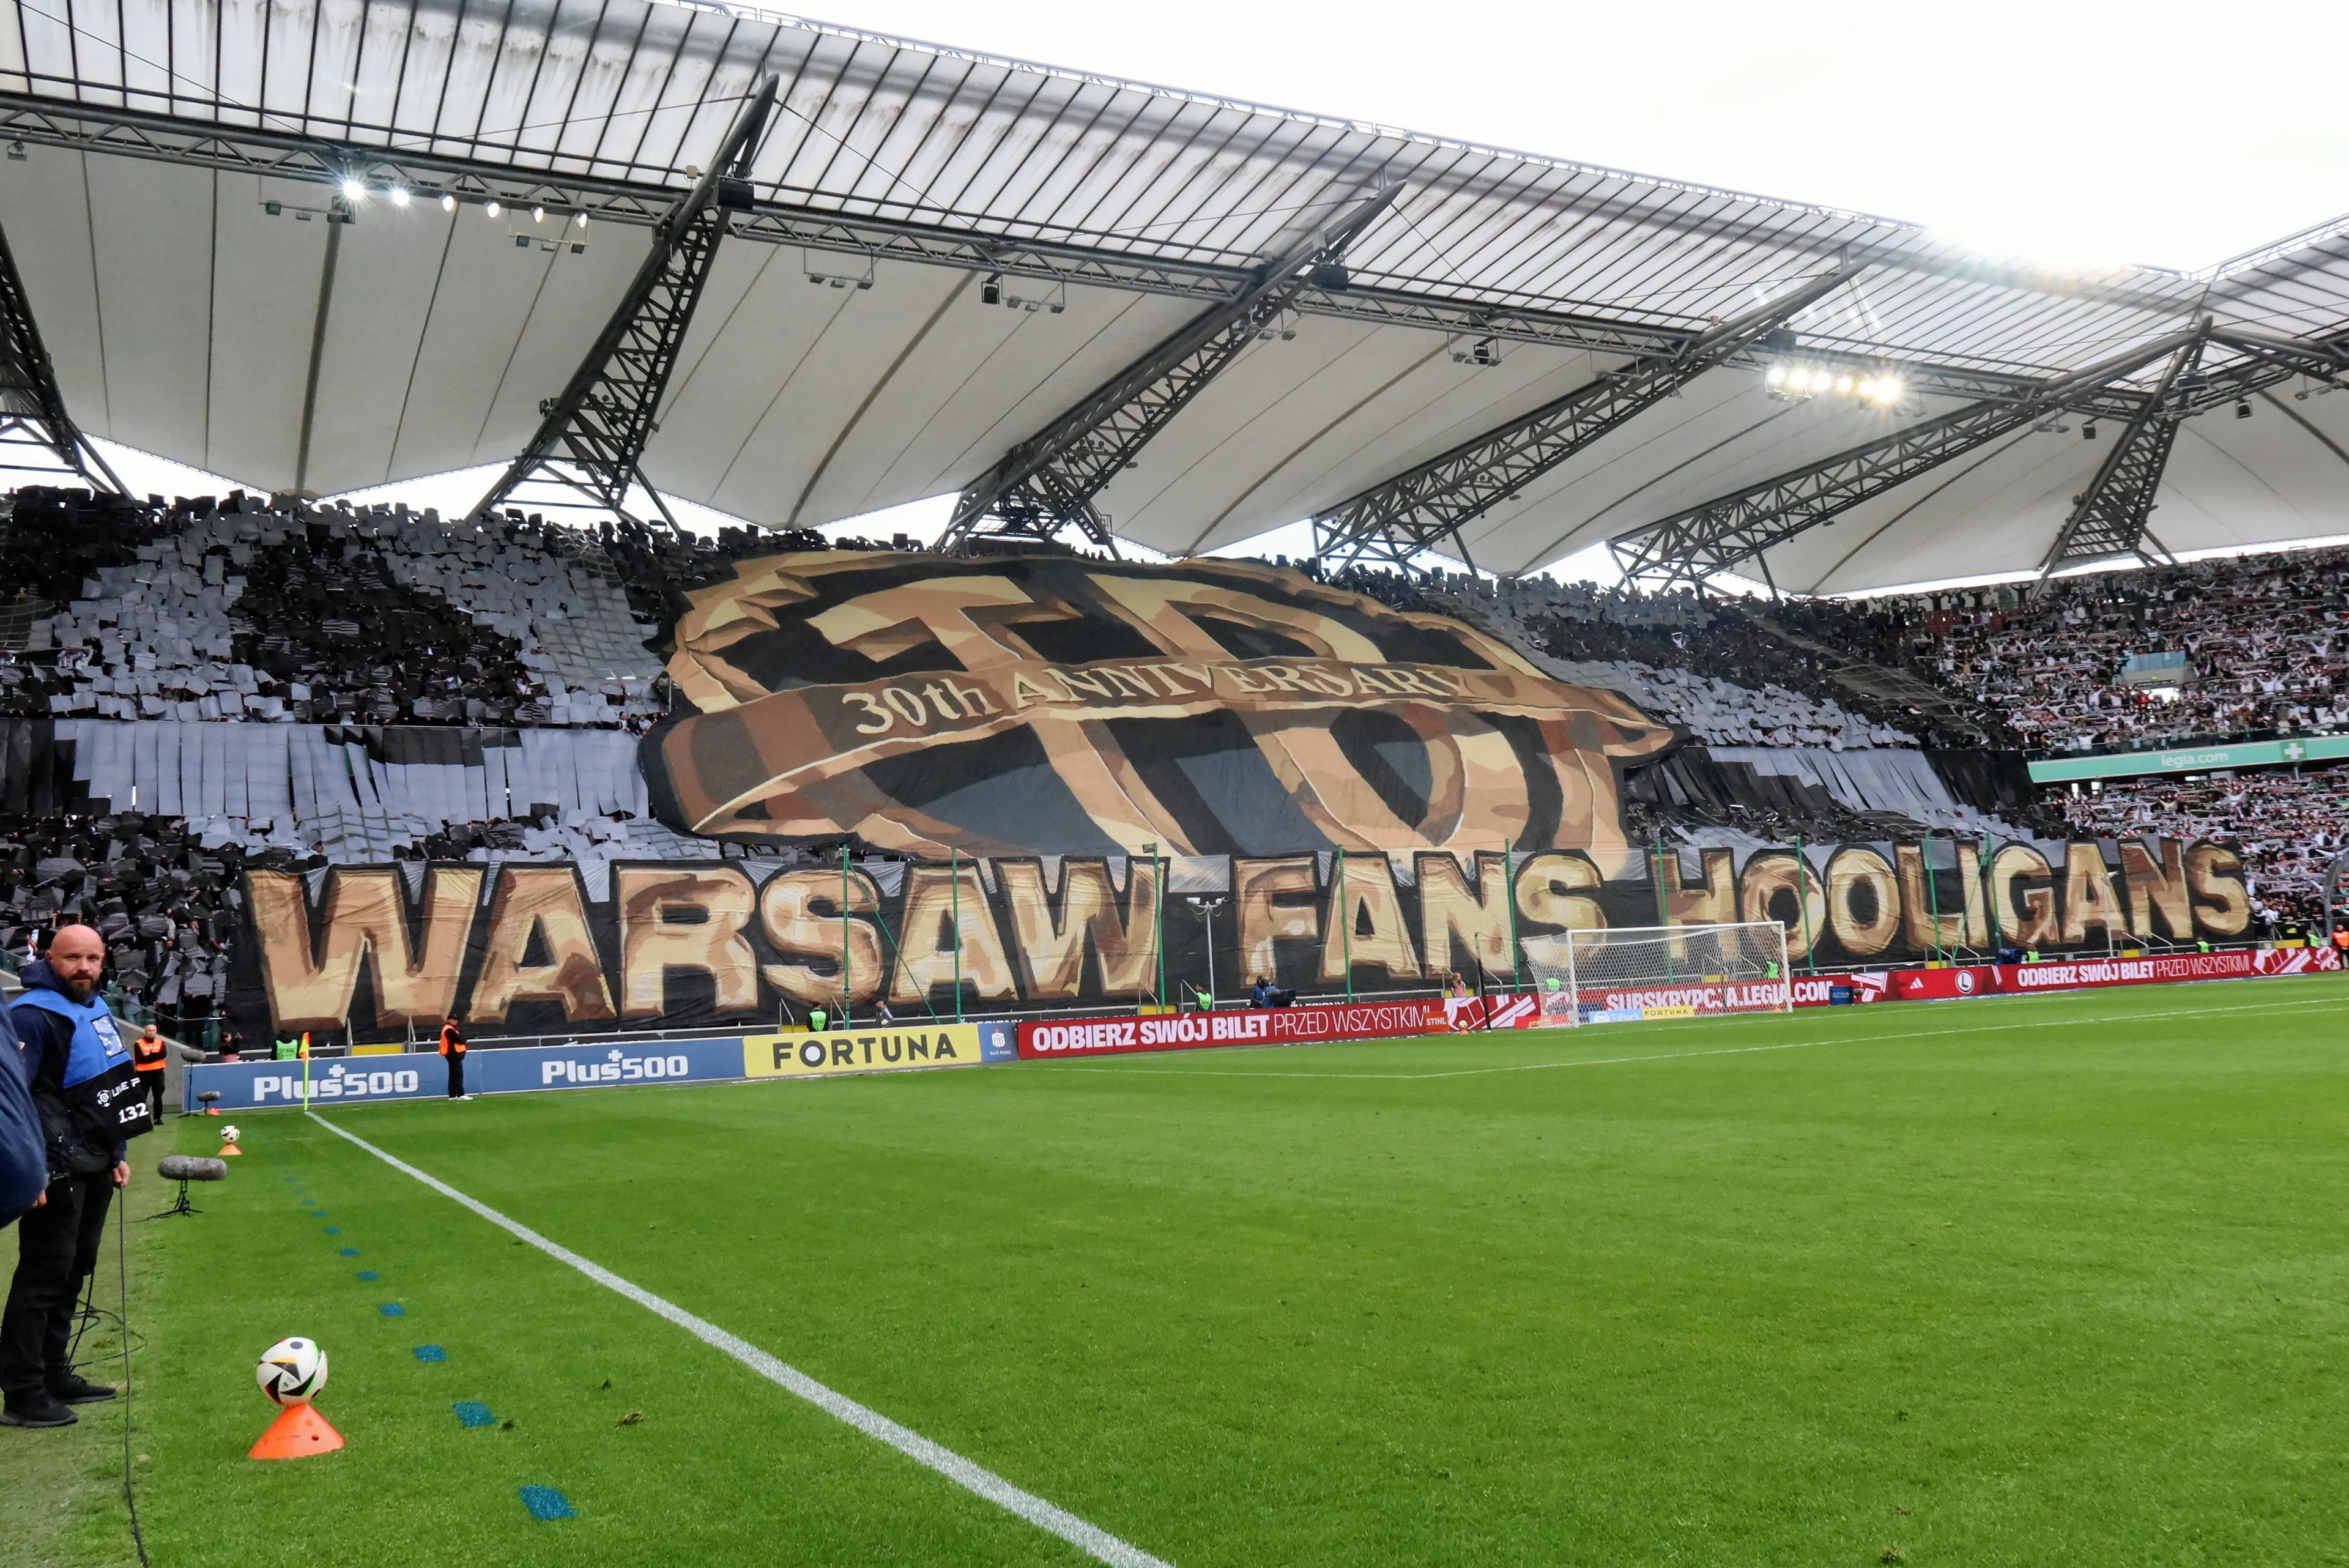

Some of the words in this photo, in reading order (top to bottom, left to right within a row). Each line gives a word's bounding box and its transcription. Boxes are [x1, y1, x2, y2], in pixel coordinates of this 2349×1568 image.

[842, 678, 1003, 734] 30th
[1013, 662, 1483, 710] ANNIVERSARY
[2161, 752, 2229, 768] legia.com
[247, 859, 1166, 1030] WARSAW
[1236, 855, 1606, 986] FANS
[1653, 842, 2251, 961] HOOLIGANS
[2017, 965, 2077, 986] ODBIERZ
[2079, 959, 2120, 983] SWÓJ
[2121, 961, 2154, 980] BILET
[2156, 958, 2189, 977] PRZED
[1033, 1022, 1136, 1051] ODBIERZ
[1140, 1013, 1208, 1044] SWÓJ
[1212, 1014, 1269, 1039] BILET
[1274, 1011, 1328, 1036] PRZED
[1426, 1017, 1447, 1025] STIHL
[542, 1050, 688, 1084] Plus500
[773, 1033, 957, 1069] FORTUNA
[253, 1064, 418, 1101] Plus500
[119, 1102, 149, 1123] 132
